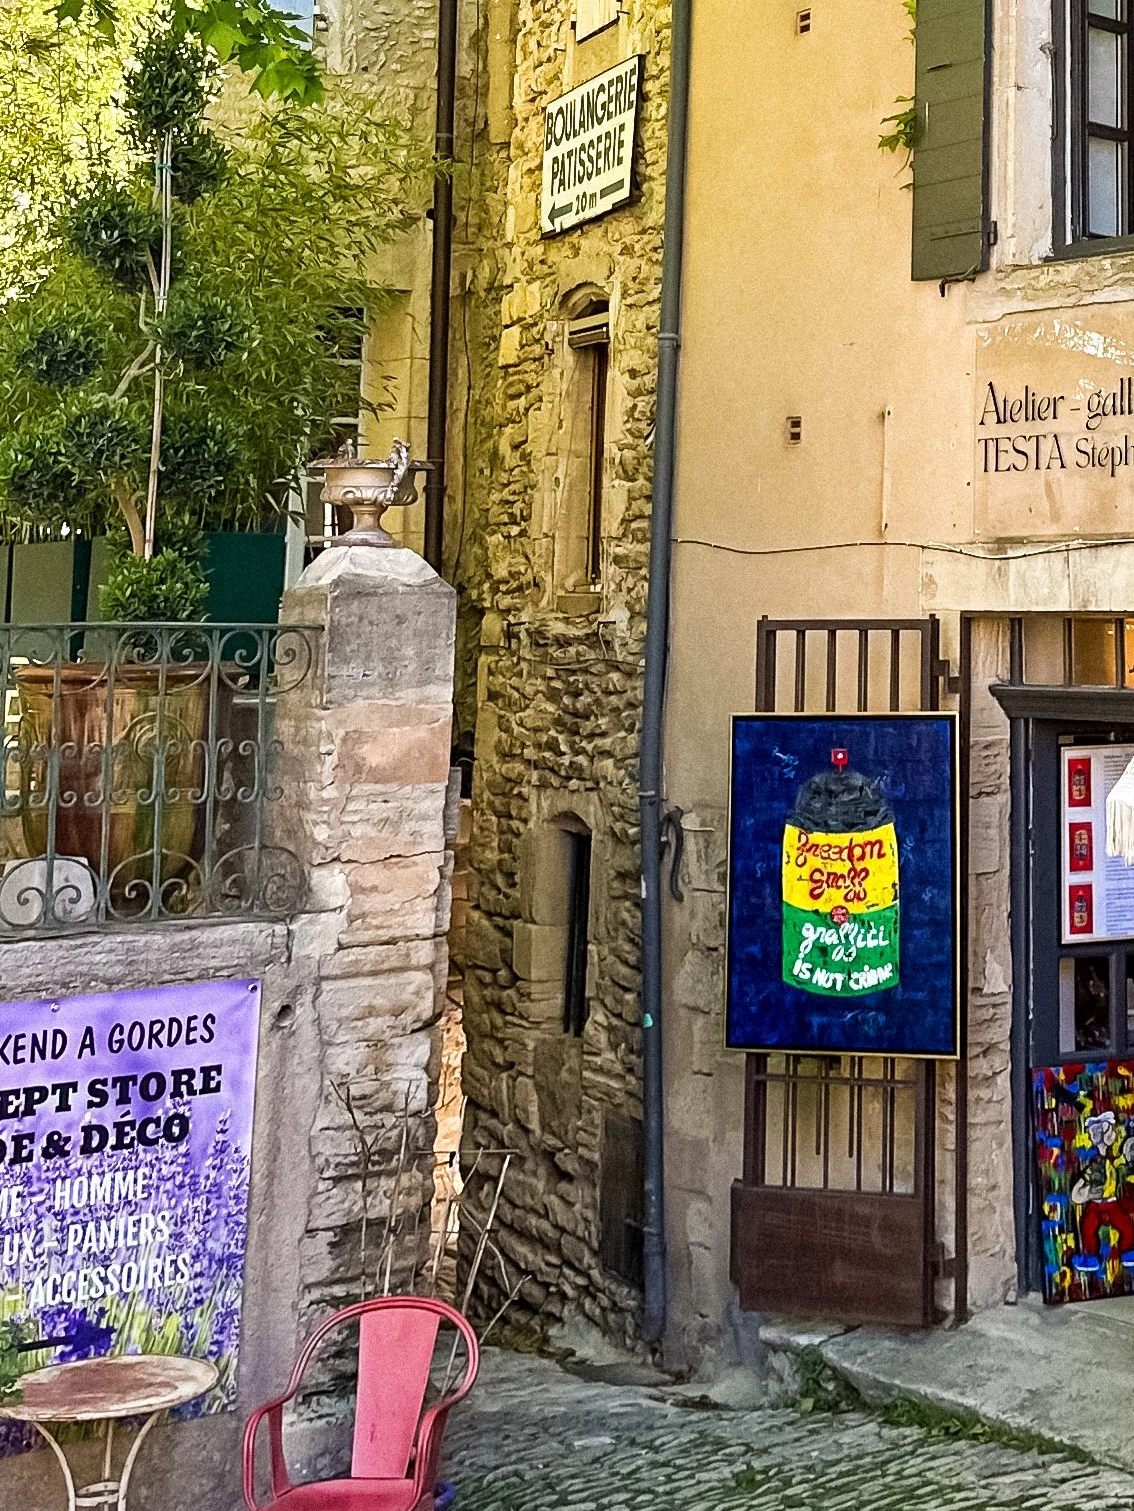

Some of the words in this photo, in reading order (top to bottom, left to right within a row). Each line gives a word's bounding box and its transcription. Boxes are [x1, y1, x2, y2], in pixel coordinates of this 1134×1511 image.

[545, 63, 637, 152] BOULANGERIE
[551, 122, 626, 197] PATISSERIE
[979, 380, 1064, 426] Atelier
[977, 433, 1067, 473] TESTA
[77, 1025, 96, 1060] A
[107, 1012, 217, 1055] GORDES
[86, 1063, 224, 1110] STORE
[40, 1130, 72, 1160] &
[80, 1110, 191, 1157] DÉCO
[54, 1166, 151, 1212] HOMME
[66, 1210, 171, 1256] PANIERS
[29, 1252, 191, 1310] ACCESSOIRES
